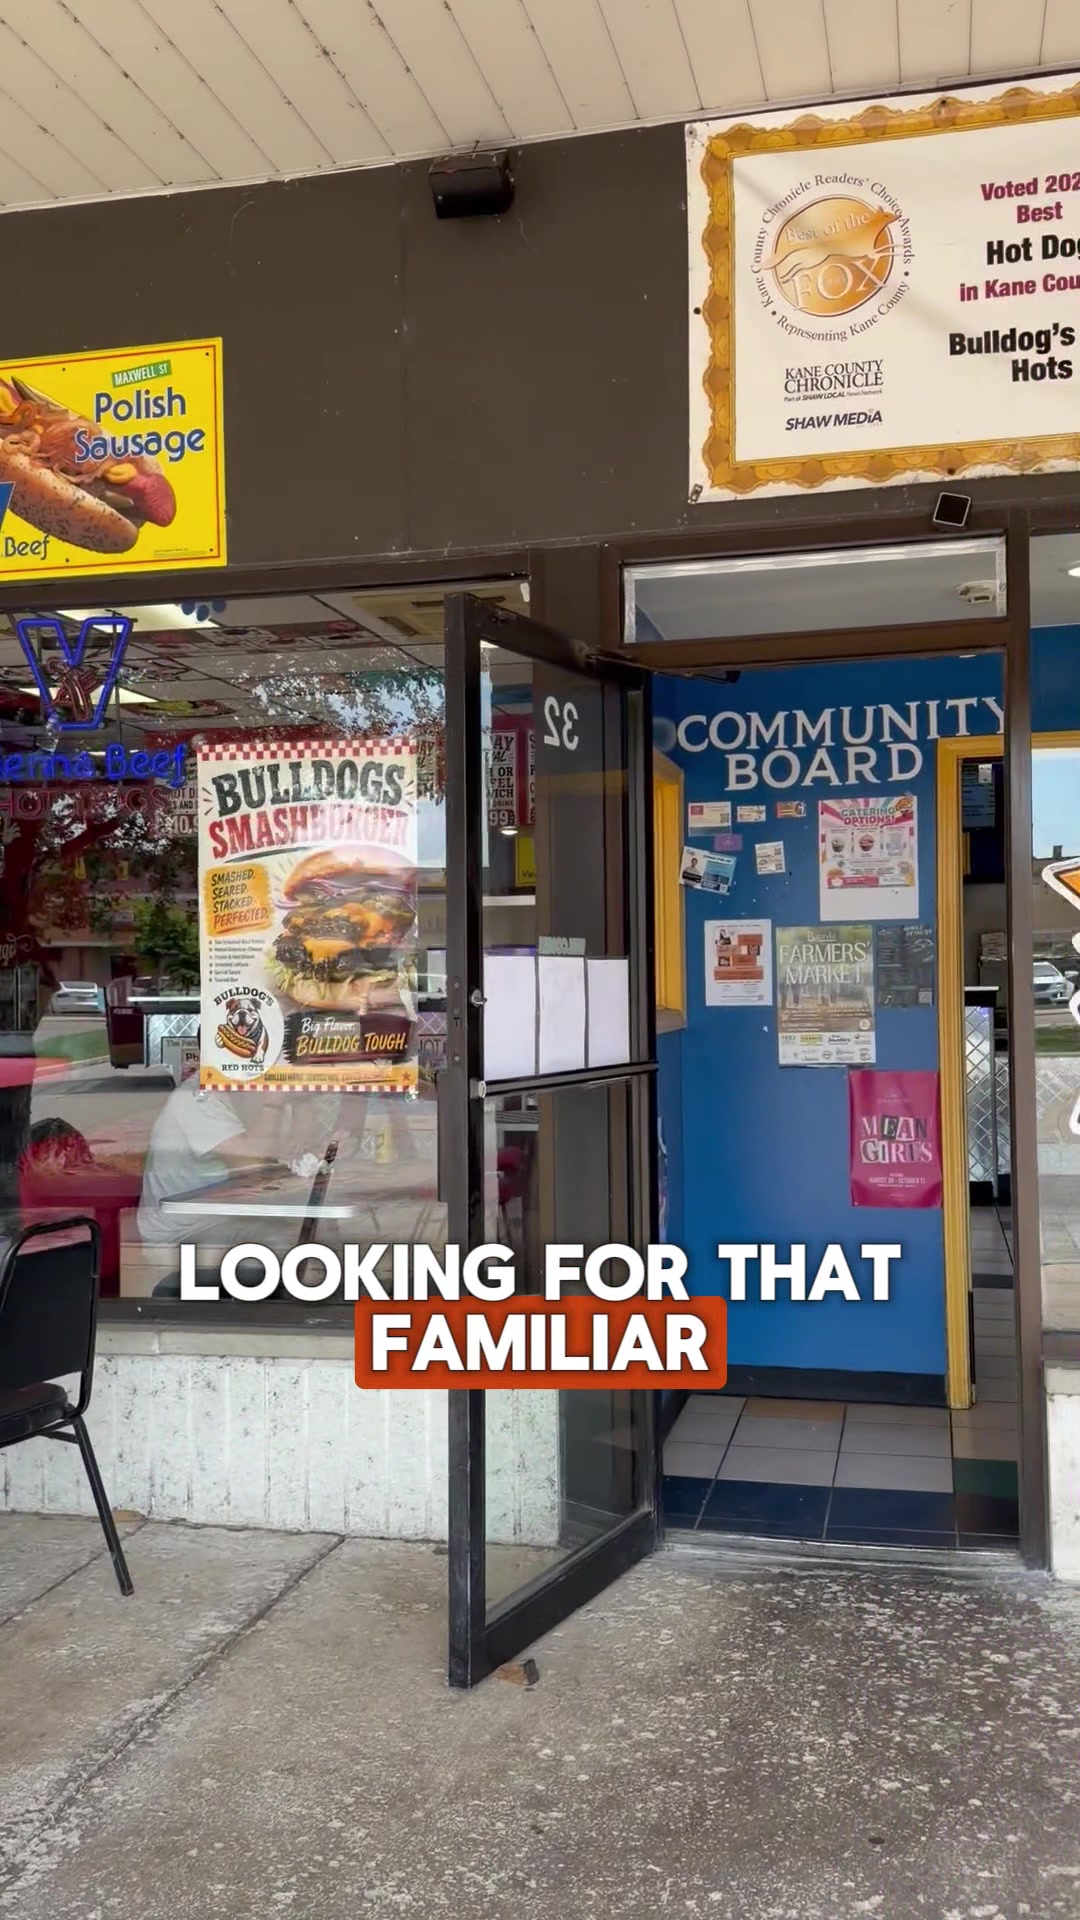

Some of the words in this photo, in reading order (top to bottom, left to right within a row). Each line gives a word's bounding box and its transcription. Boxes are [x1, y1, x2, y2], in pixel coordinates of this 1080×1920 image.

[870, 182, 903, 219] Choice
[981, 177, 1039, 201] Voted
[762, 181, 811, 224] Chronicle
[1017, 201, 1063, 224] Best
[844, 213, 870, 231] the
[751, 227, 769, 274] County
[899, 217, 915, 265] Awards
[987, 237, 1033, 266] Hot
[756, 277, 773, 309] Kane
[789, 256, 887, 311] FOX
[960, 283, 979, 302] in
[985, 279, 1037, 300] Kane
[776, 315, 848, 342] Representing
[849, 314, 879, 337] Kane
[878, 281, 910, 317] County
[949, 322, 1076, 355] Bulldog's
[114, 366, 157, 387] MAXWELL
[159, 363, 168, 375] ST
[785, 365, 821, 380] KANE
[824, 359, 884, 376] COUNTY
[1012, 356, 1074, 382] Hots
[784, 371, 884, 393] CHRONICLE
[95, 386, 187, 424] Polish
[802, 393, 823, 401] SHAW
[824, 391, 846, 399] LOCAL
[785, 414, 833, 431] SHAW
[74, 428, 206, 463] Sausage
[4, 534, 51, 561] Beef
[677, 696, 1004, 753] COMMUNITY
[106, 743, 188, 790] Beef
[724, 742, 924, 791] BOARD
[211, 759, 405, 817] BULLDOGS
[841, 807, 896, 817] CATERING
[843, 815, 896, 826] OPTIONS!
[208, 803, 409, 860] SMASHBURGER
[211, 868, 256, 887] SMASHED.
[213, 907, 270, 930] PERFECTED.
[780, 941, 871, 964] FARMERS'
[786, 963, 864, 985] MARKET
[213, 986, 275, 1007] BULLDOG'S
[301, 1017, 321, 1037] Big
[296, 1035, 360, 1057] BULLDOG
[364, 1032, 409, 1052] TOUGH.
[222, 1064, 239, 1072] RED
[241, 1064, 265, 1072] HOTS
[862, 1115, 928, 1140] MEAN
[861, 1139, 933, 1164] GIRLS
